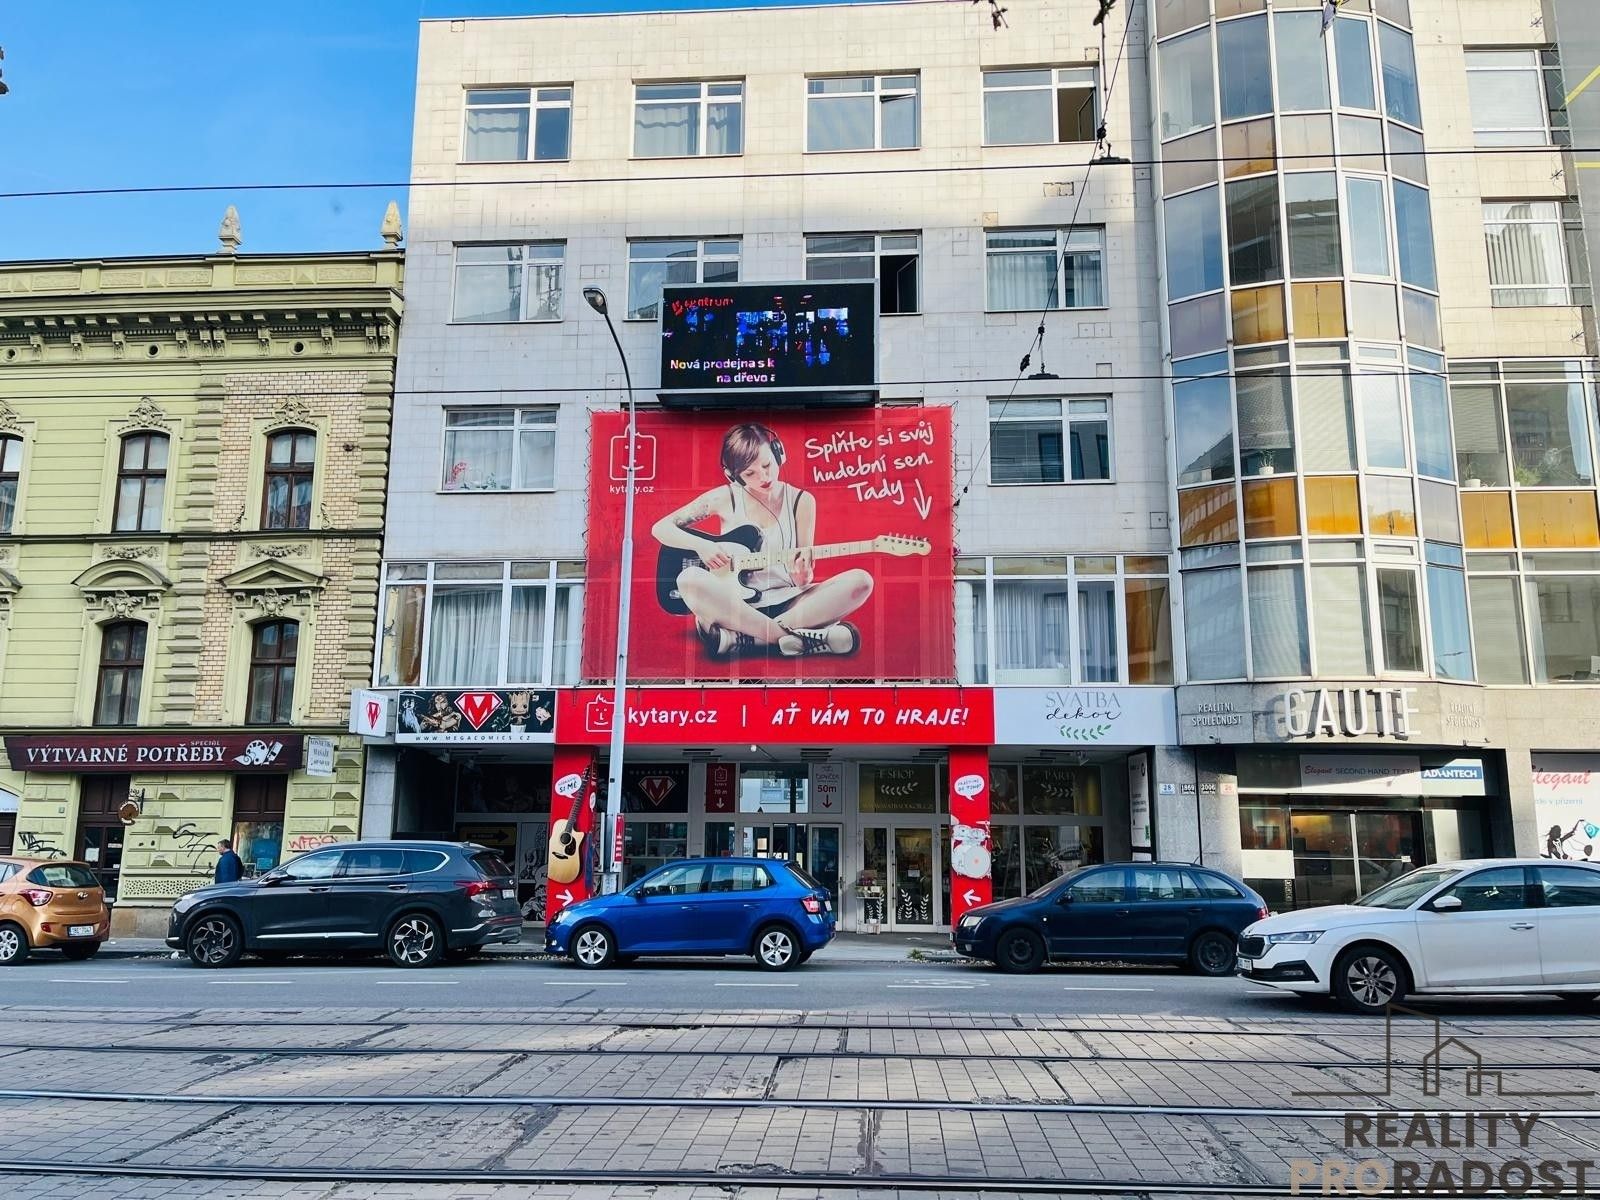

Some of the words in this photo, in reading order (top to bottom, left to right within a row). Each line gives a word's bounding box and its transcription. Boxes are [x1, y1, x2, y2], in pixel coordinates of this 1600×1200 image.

[670, 359, 700, 370] Nová
[703, 358, 756, 372] prodejna
[716, 374, 731, 383] na
[734, 372, 768, 383] dřevo
[805, 431, 872, 462] Splňte
[877, 428, 893, 445] si
[899, 421, 933, 445] svůj
[814, 454, 886, 483] hudební
[610, 485, 655, 495] kyty.cz
[847, 479, 904, 505] Tady
[1046, 691, 1121, 708] SVATBA
[628, 706, 717, 727] kytary.cz
[771, 702, 802, 726] AŤ
[811, 702, 850, 726] VÁM
[860, 707, 885, 725] TO
[896, 707, 969, 726] HRAJE!
[1046, 707, 1122, 720] dekor
[1284, 687, 1421, 736] GAUTE
[27, 744, 129, 763] VÝTVARNÉ
[136, 743, 227, 763] POTŘEBY
[1423, 769, 1477, 779] ADVANTECH
[817, 784, 837, 793] 50m
